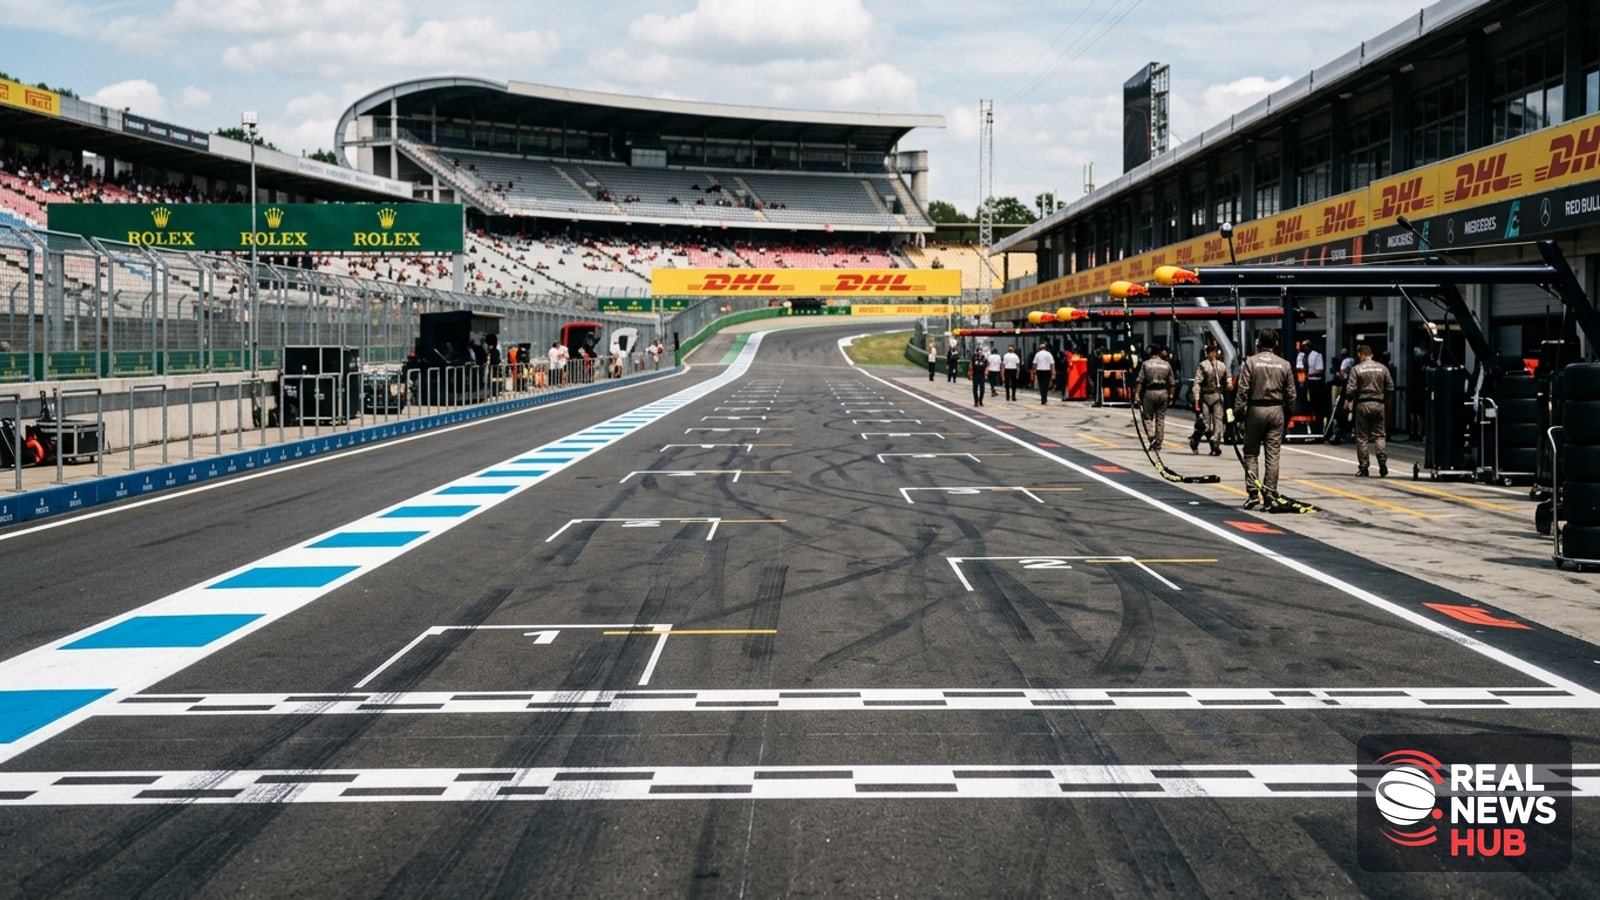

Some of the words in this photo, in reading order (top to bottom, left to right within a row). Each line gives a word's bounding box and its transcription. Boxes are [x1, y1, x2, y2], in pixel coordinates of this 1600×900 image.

[1547, 125, 1600, 180] DH
[1454, 153, 1511, 202] DHL
[1381, 177, 1425, 218] DHL
[1565, 199, 1581, 216] RED
[1323, 200, 1358, 235] DHL
[128, 231, 195, 246] ROLEX
[240, 232, 308, 246] ROLEX
[353, 232, 421, 246] ROLEX
[1275, 215, 1304, 246] DHL
[702, 274, 781, 291] DHL
[835, 274, 913, 291] DHL
[1018, 558, 1072, 569] 2
[523, 630, 561, 644] 1
